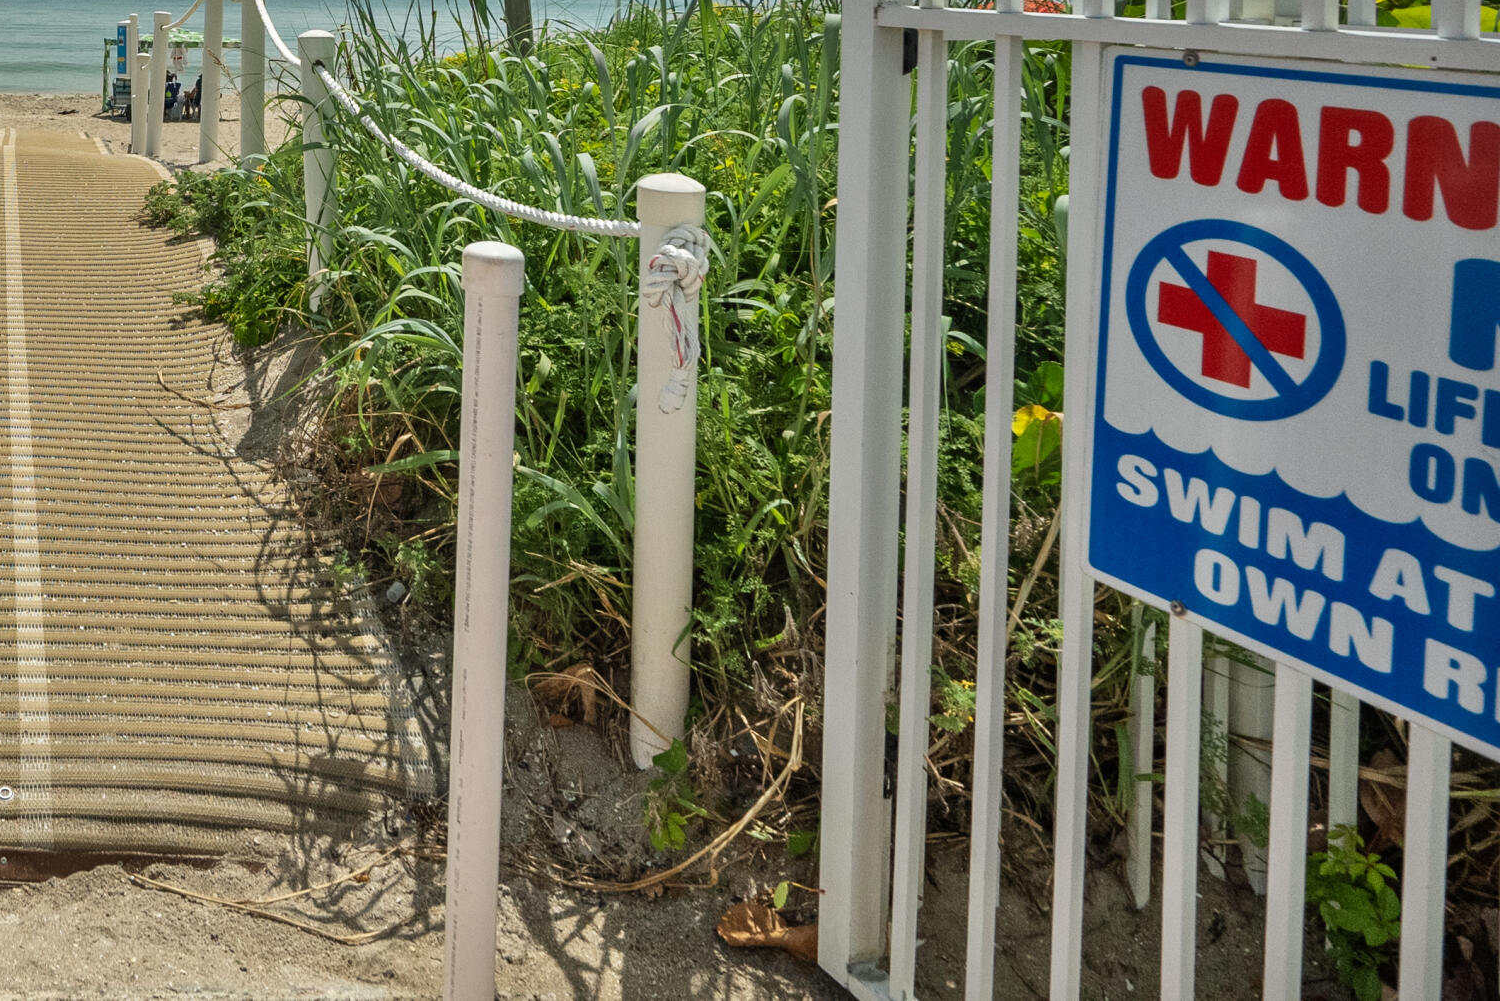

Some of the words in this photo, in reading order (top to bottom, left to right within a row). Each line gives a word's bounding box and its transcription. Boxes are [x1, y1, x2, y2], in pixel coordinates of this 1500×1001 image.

[1141, 85, 1500, 231] WARN
[1116, 454, 1345, 583] SWIM
[1369, 548, 1495, 632] AT
[1194, 548, 1394, 674] OWN
[1423, 638, 1500, 724] R
